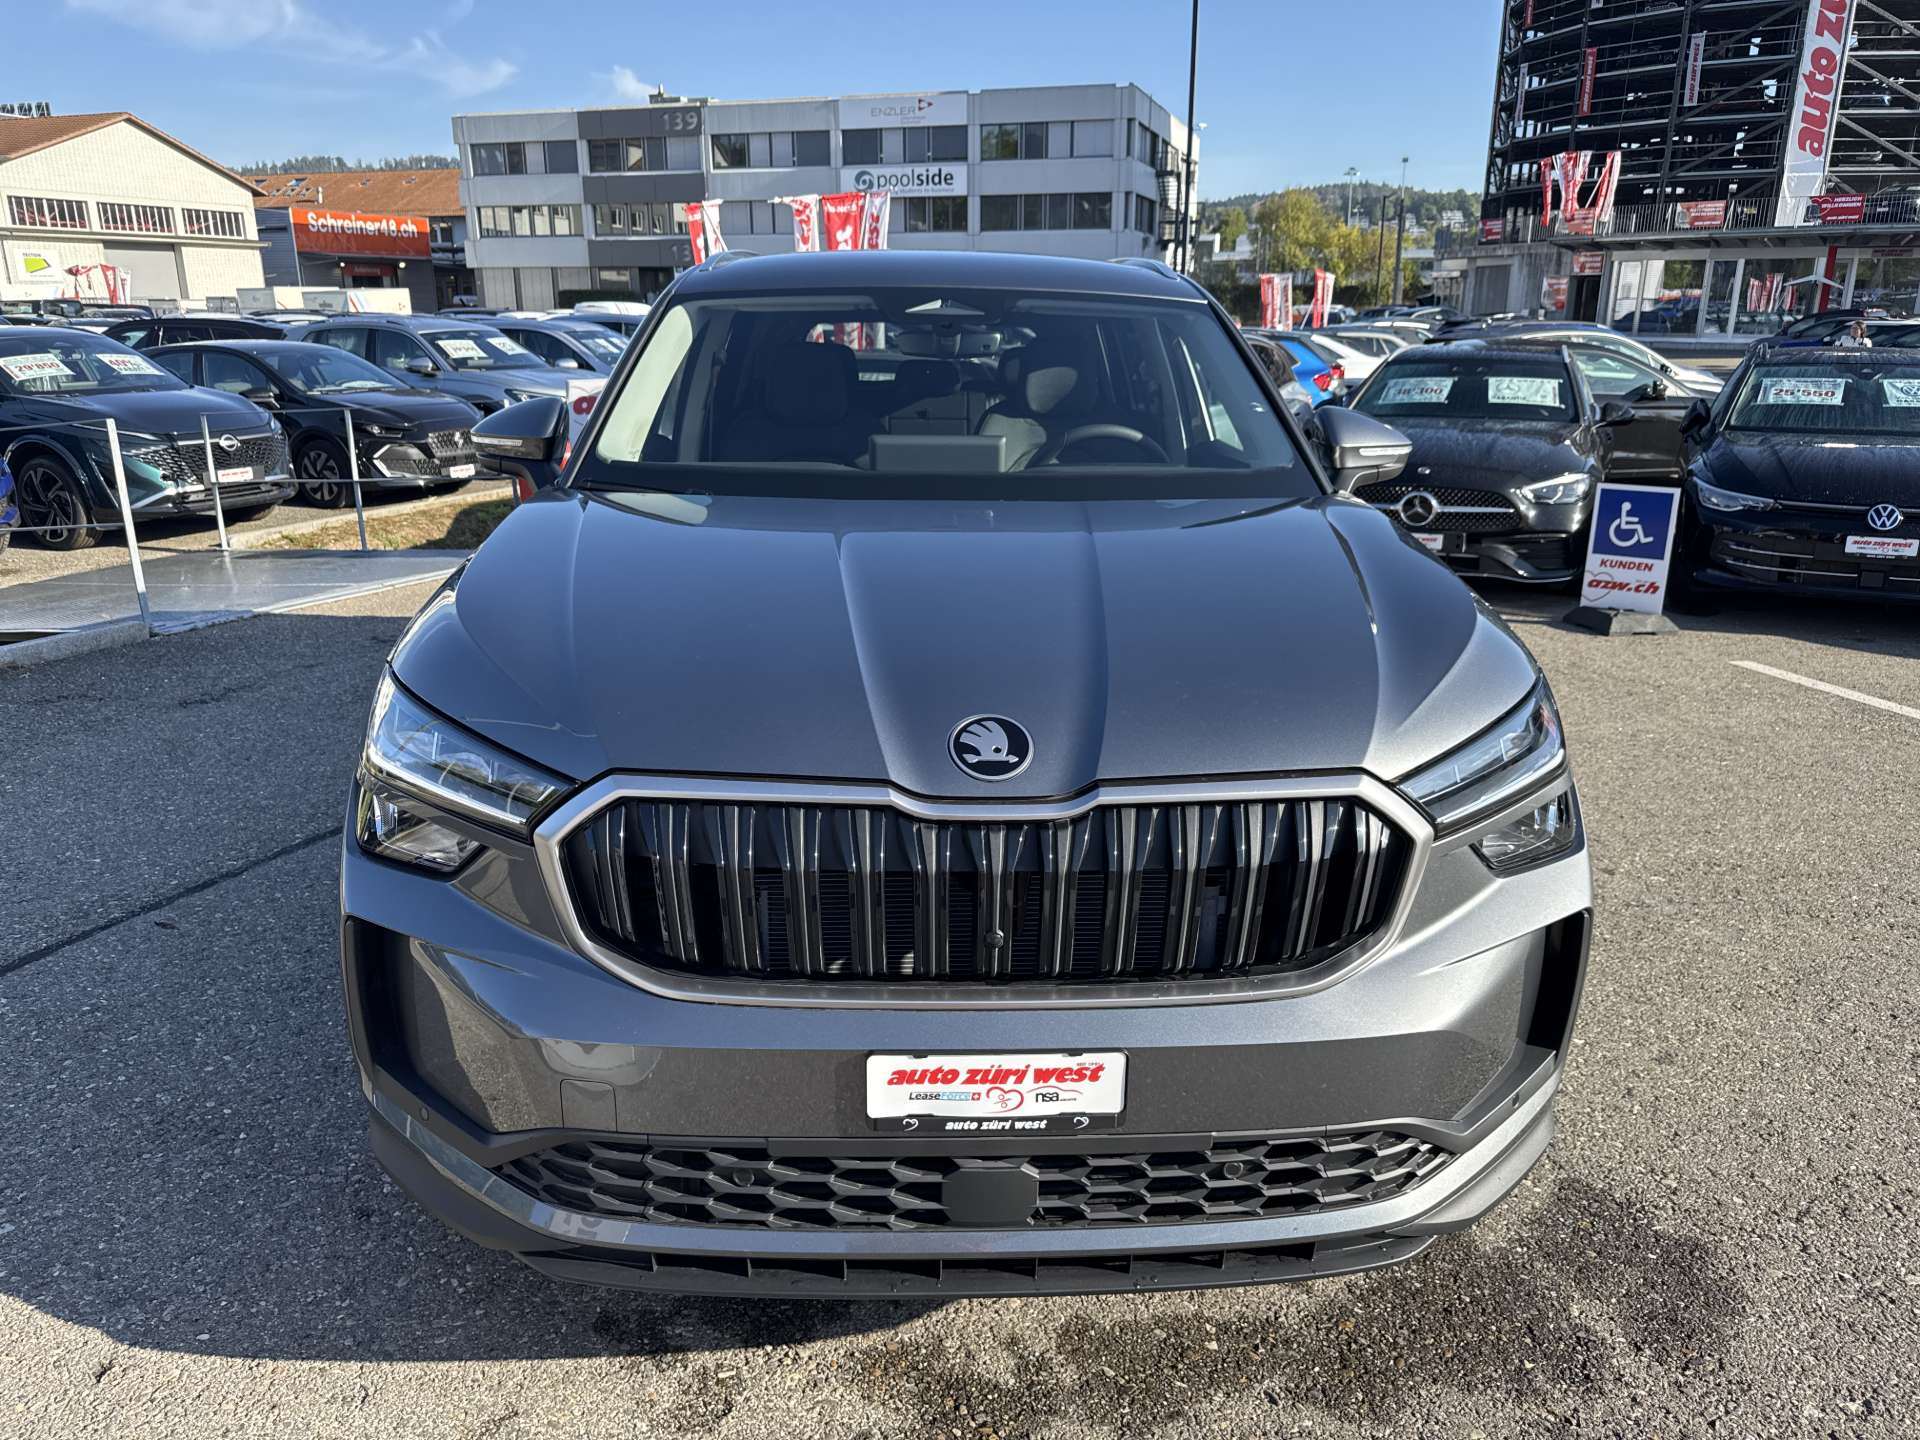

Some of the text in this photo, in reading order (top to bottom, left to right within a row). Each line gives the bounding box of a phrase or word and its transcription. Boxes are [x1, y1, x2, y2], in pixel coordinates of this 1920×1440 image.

[1798, 46, 1838, 157] auto
[871, 106, 916, 117] ENZLER
[662, 112, 698, 131] 139
[877, 168, 954, 190] poolside
[307, 211, 418, 239] Schreiner48.ch
[1773, 388, 1836, 398] 25'550
[1600, 558, 1653, 571] KUNDEN
[1588, 579, 1659, 594] azw.ch
[887, 1063, 1105, 1085] auto züri west
[1036, 1092, 1060, 1102] nsa
[945, 1120, 1047, 1130] auto züri west
